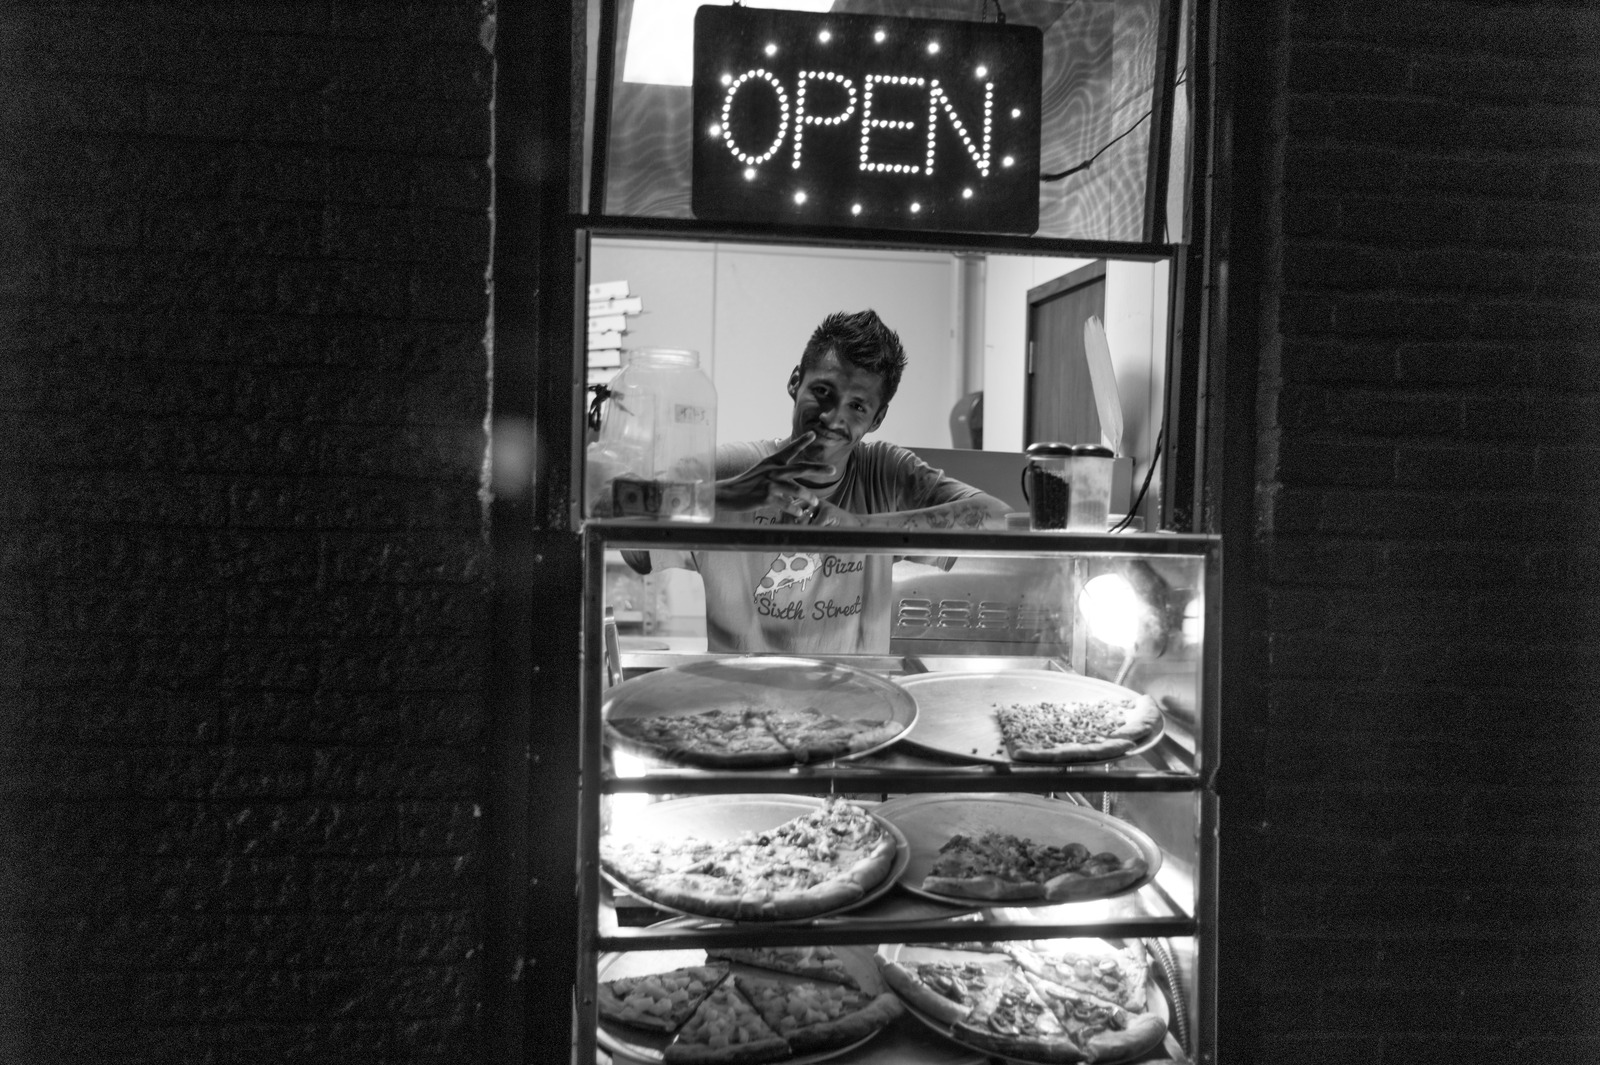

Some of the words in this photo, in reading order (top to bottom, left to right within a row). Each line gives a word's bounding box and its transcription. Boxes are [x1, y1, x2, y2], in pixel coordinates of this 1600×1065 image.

[721, 68, 993, 177] OPEN
[823, 555, 863, 577] Pizza
[757, 598, 805, 620] Sixth
[812, 595, 862, 620] Street
